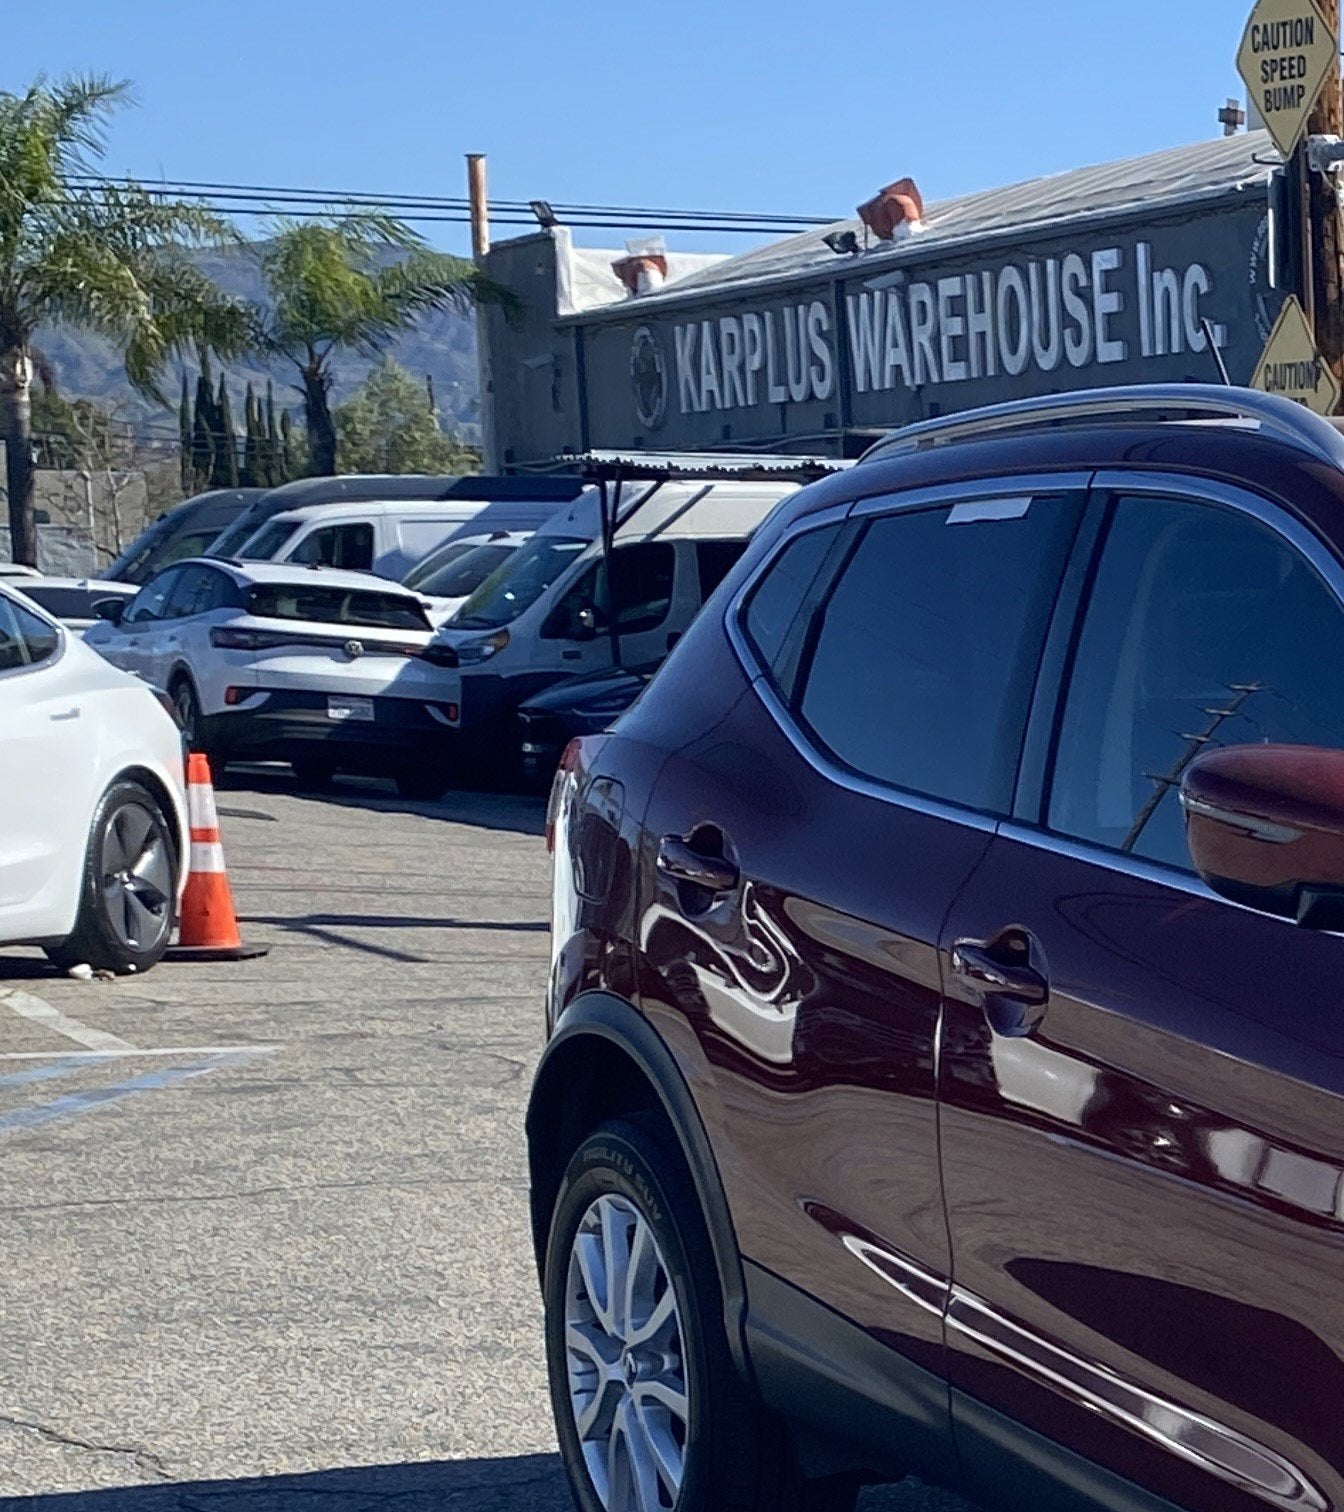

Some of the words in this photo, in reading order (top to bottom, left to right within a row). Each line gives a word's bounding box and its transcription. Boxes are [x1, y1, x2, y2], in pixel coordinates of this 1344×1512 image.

[1251, 16, 1314, 54] CAUTION
[1261, 55, 1306, 84] SPEED
[1264, 84, 1305, 112] BUMP
[673, 301, 833, 414] KARPLUS
[846, 247, 1129, 394] WAREHOUSE
[1137, 240, 1228, 358] Inc.
[1264, 361, 1316, 392] CAUTION
